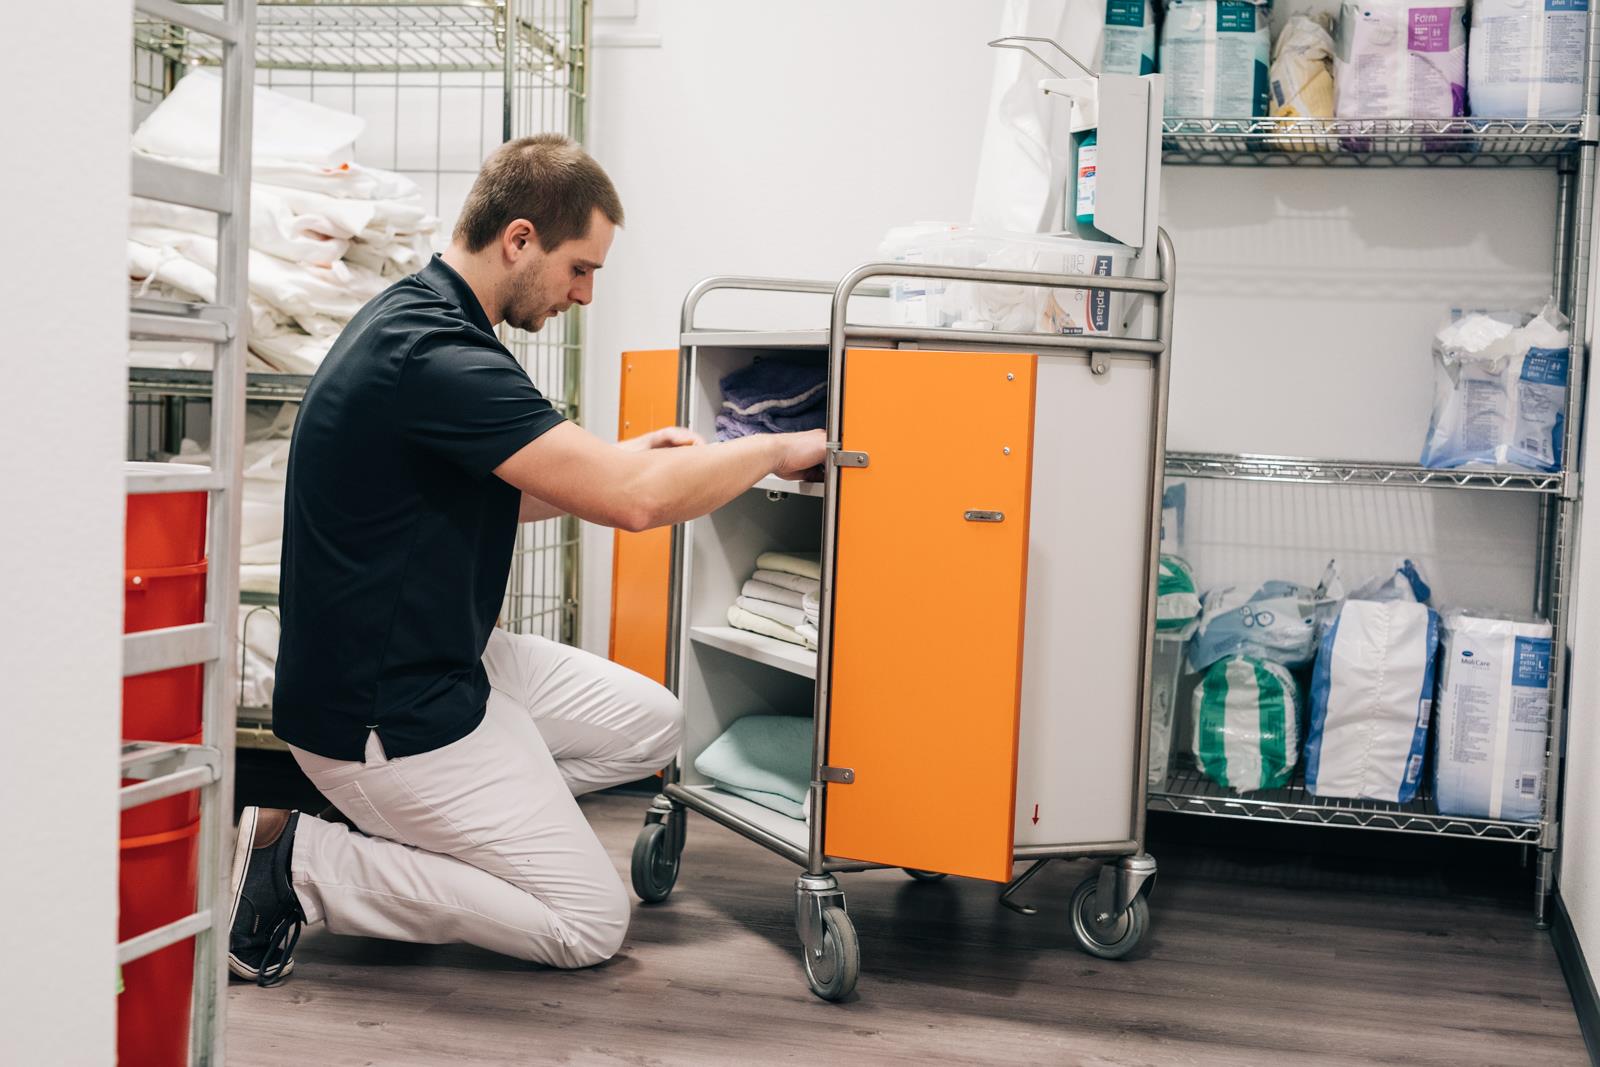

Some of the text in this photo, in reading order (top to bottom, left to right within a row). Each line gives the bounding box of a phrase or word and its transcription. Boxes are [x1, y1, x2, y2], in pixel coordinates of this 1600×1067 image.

[1414, 13, 1438, 23] Form
[1096, 260, 1108, 326] Haaplast
[1538, 660, 1544, 669] L
